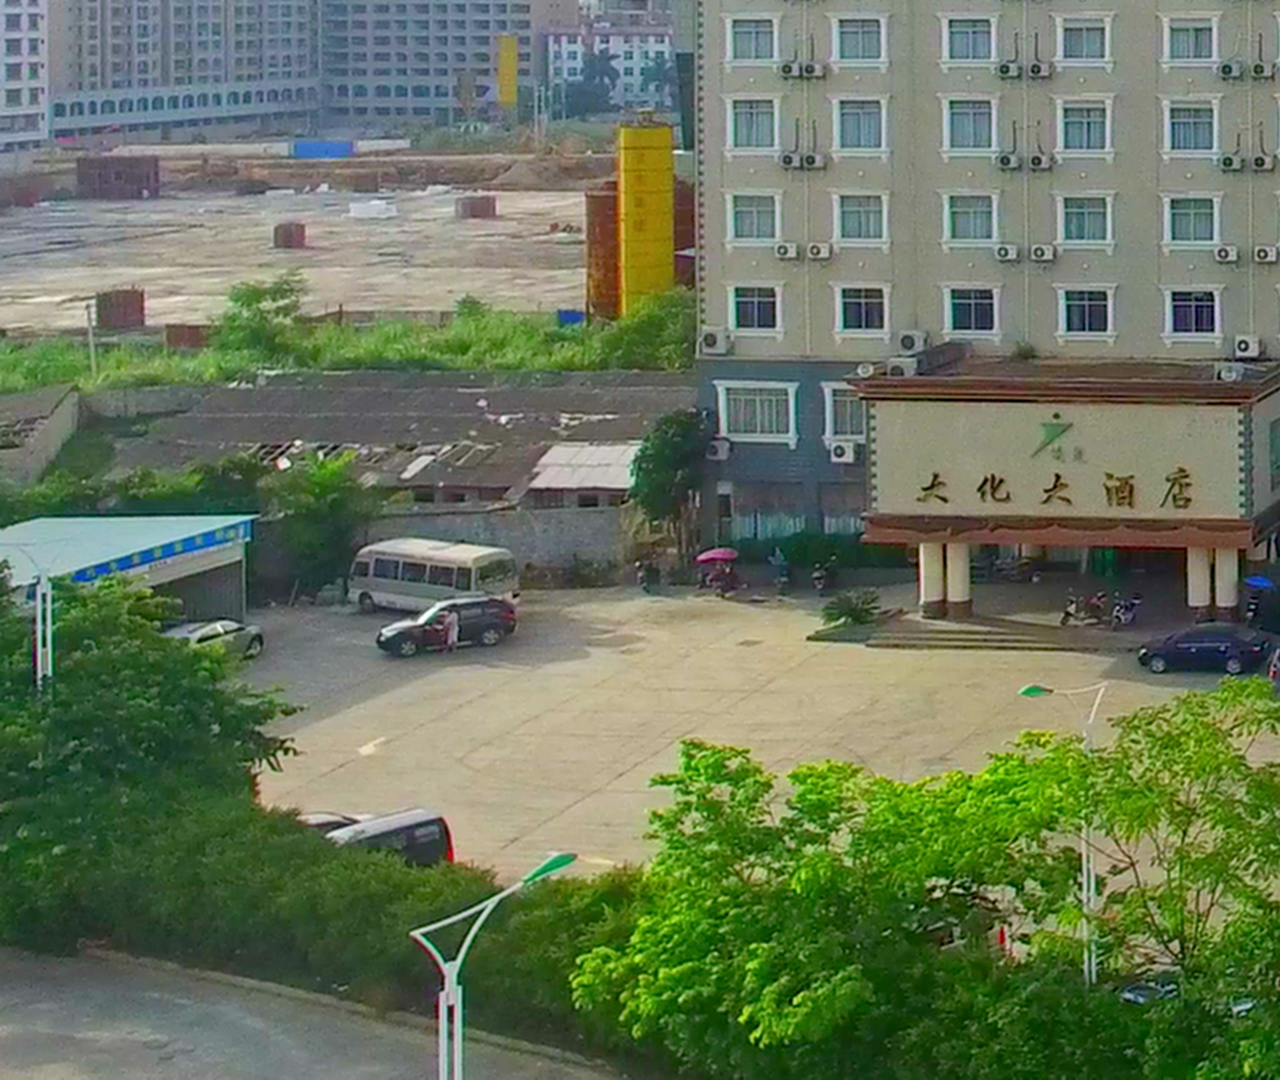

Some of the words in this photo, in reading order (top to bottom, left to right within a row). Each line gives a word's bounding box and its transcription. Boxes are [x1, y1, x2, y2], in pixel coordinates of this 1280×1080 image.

[916, 467, 1193, 510] 大化大酒店
